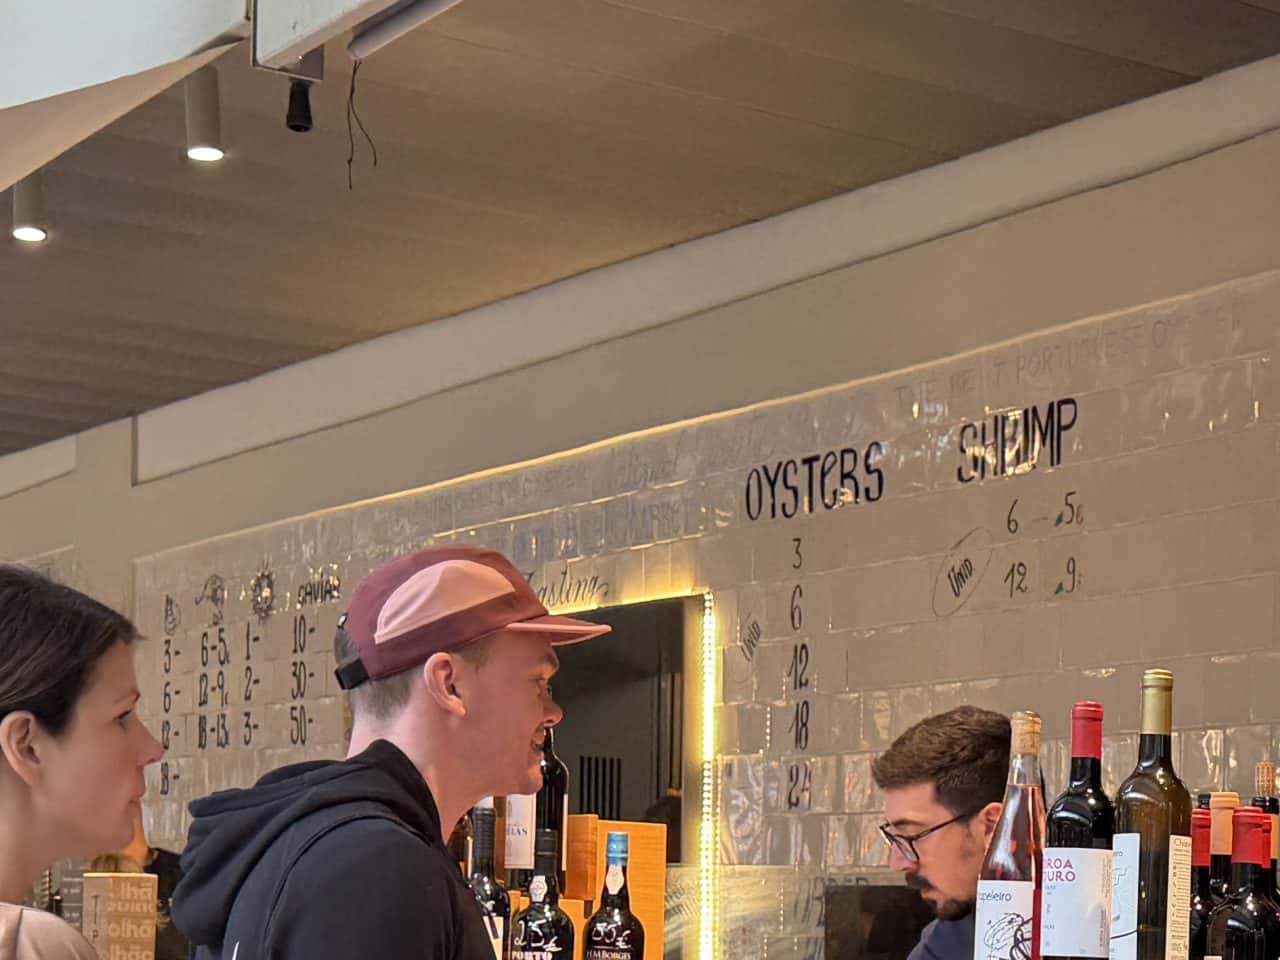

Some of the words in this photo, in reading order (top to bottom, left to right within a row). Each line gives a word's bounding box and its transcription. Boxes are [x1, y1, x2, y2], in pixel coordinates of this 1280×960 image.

[957, 397, 1079, 484] SHRIMP
[791, 537, 803, 570] 3
[790, 585, 803, 631] 6
[787, 643, 810, 690] 12
[788, 700, 810, 750] 18
